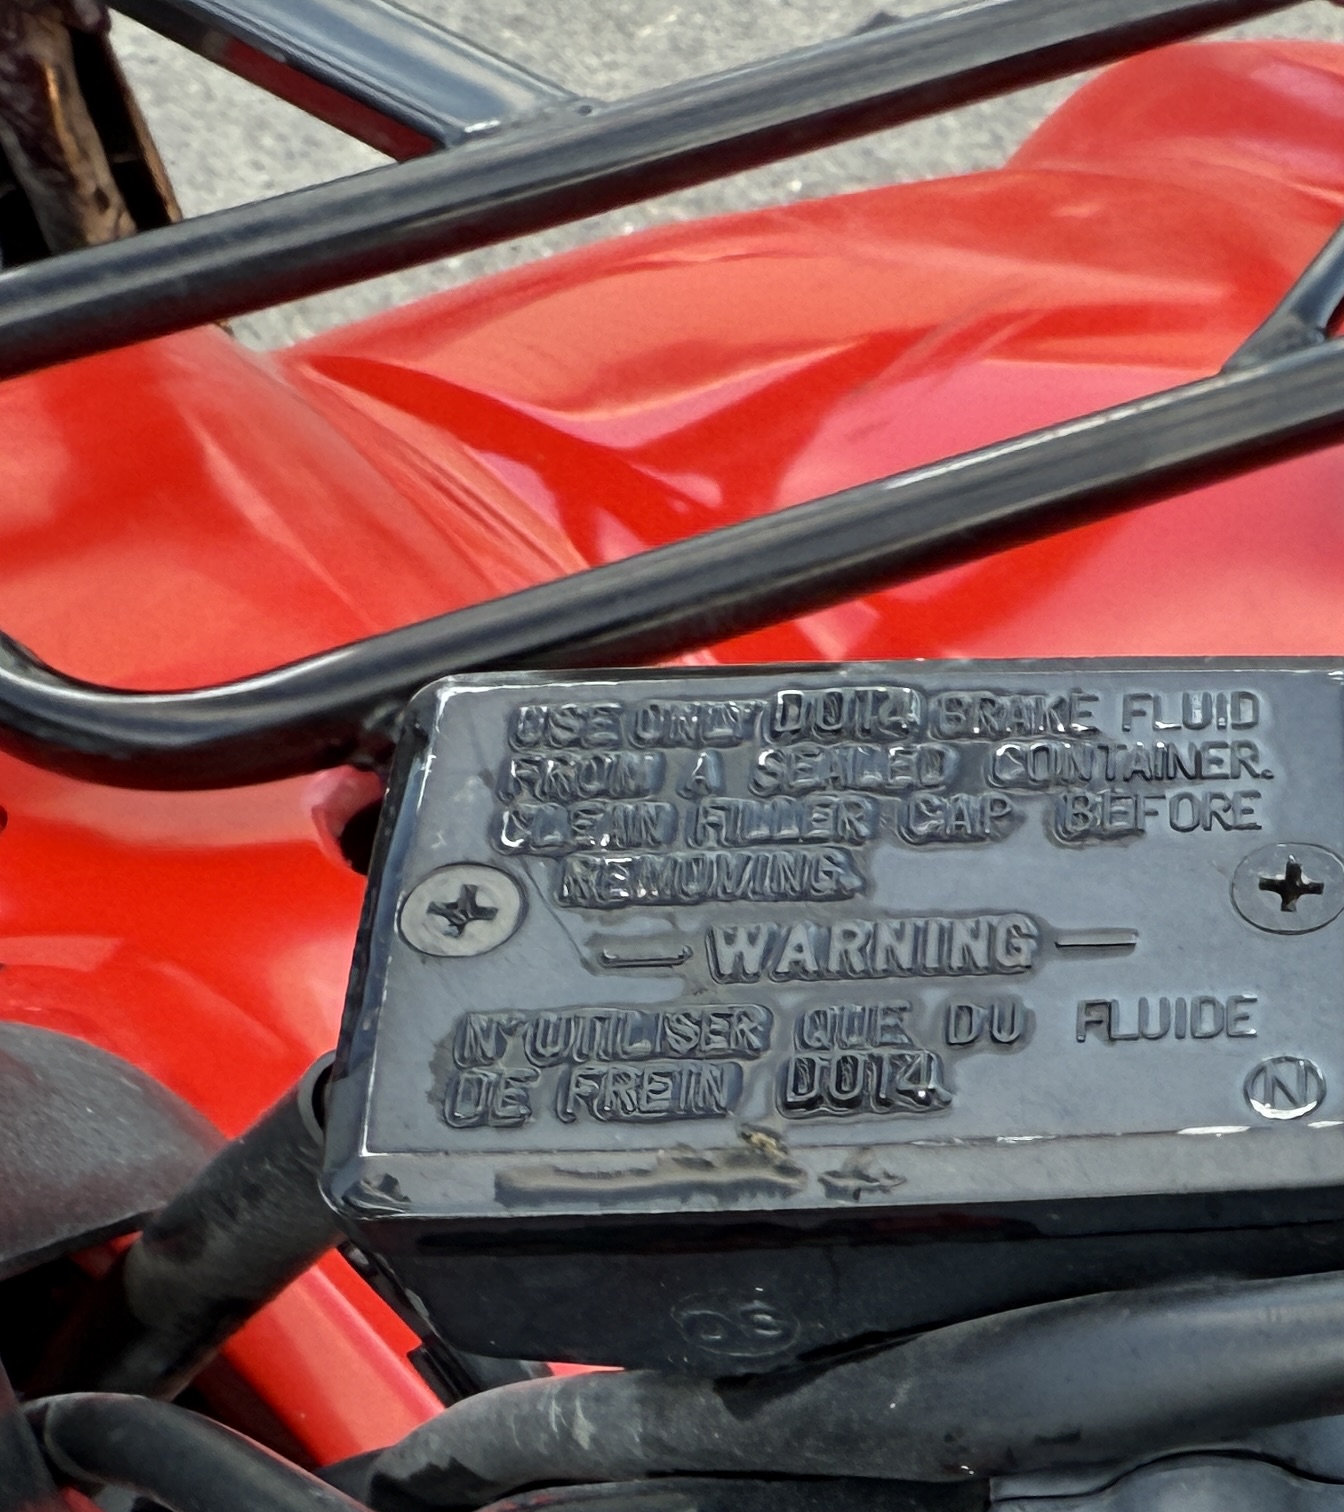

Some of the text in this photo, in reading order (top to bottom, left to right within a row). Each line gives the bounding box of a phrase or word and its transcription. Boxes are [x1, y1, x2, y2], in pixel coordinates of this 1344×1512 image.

[512, 703, 622, 747] USE
[936, 690, 1100, 736] BRAKE
[1121, 690, 1260, 732] FLUID
[506, 740, 1275, 798] FROM A SEALED CONTAINER.
[500, 789, 1263, 850] CLEAN FILLER CAP BEFORE
[708, 914, 1038, 982] WARNING
[796, 1000, 911, 1048] QUE
[944, 999, 1026, 1045] DU
[1076, 994, 1258, 1042] FLUIDE
[447, 1067, 536, 1125] DE
[558, 1063, 736, 1120] FREIN
